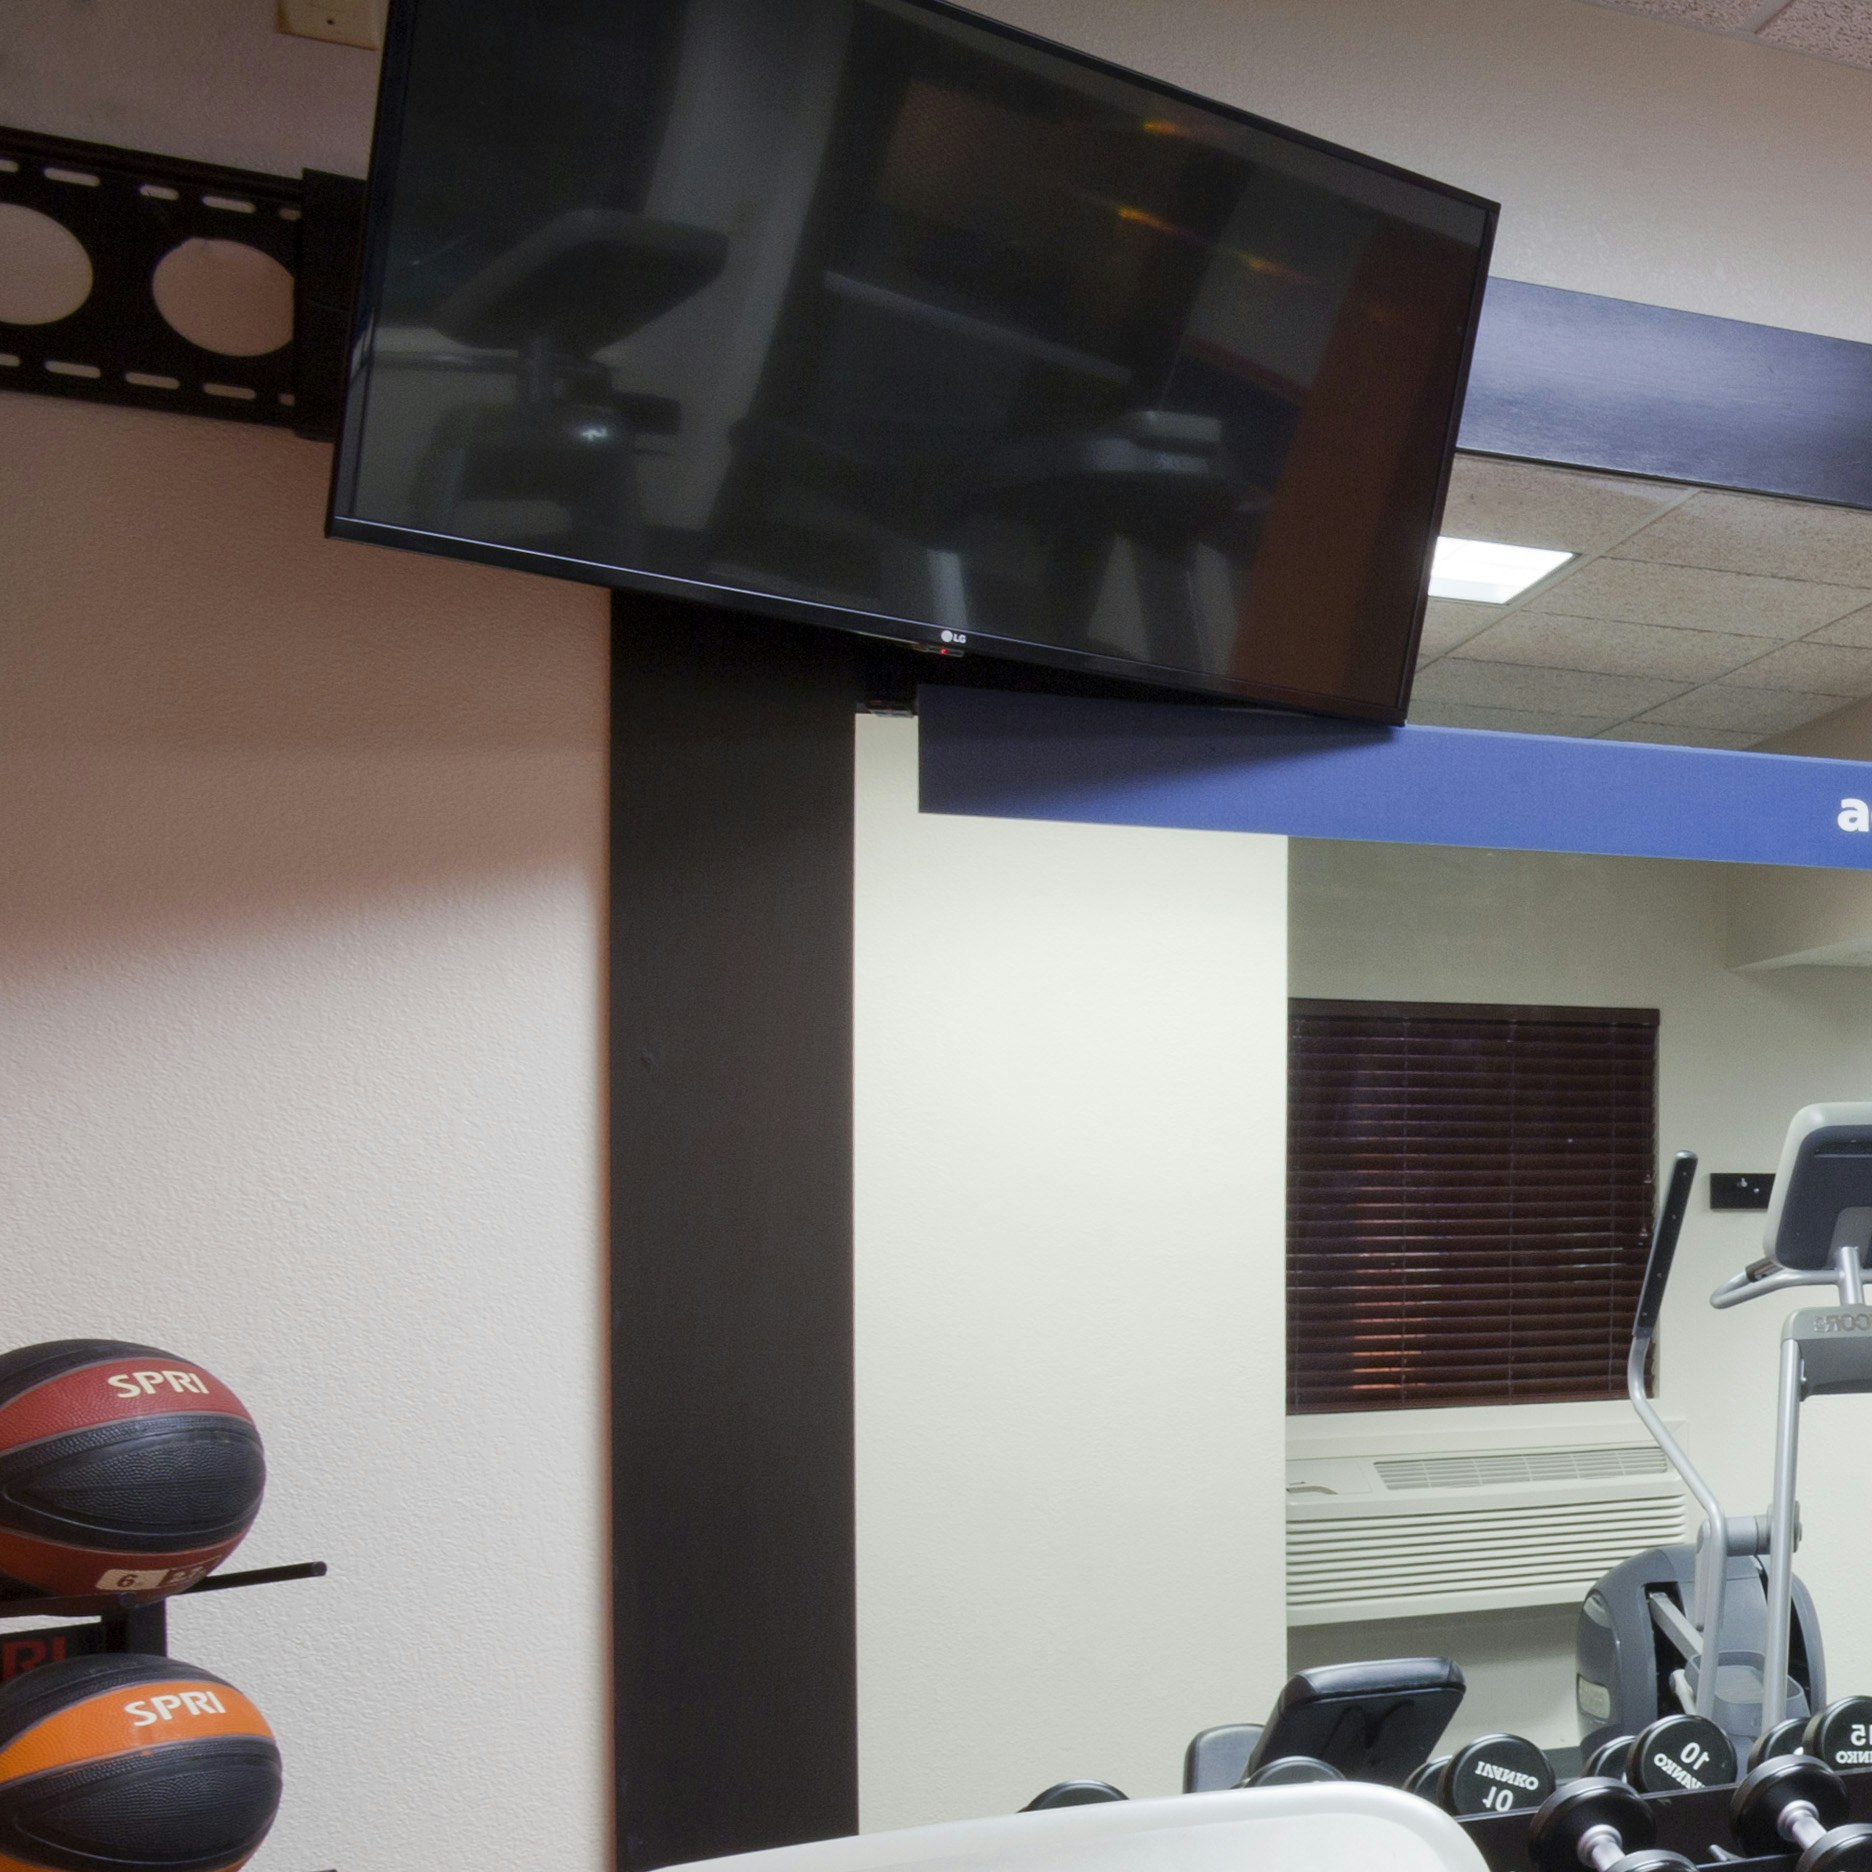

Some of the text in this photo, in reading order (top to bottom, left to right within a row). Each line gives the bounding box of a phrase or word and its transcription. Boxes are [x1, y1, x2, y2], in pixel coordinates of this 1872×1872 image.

[953, 633, 966, 644] LG
[107, 1370, 209, 1399] SPRI
[124, 1690, 226, 1726] SPRI
